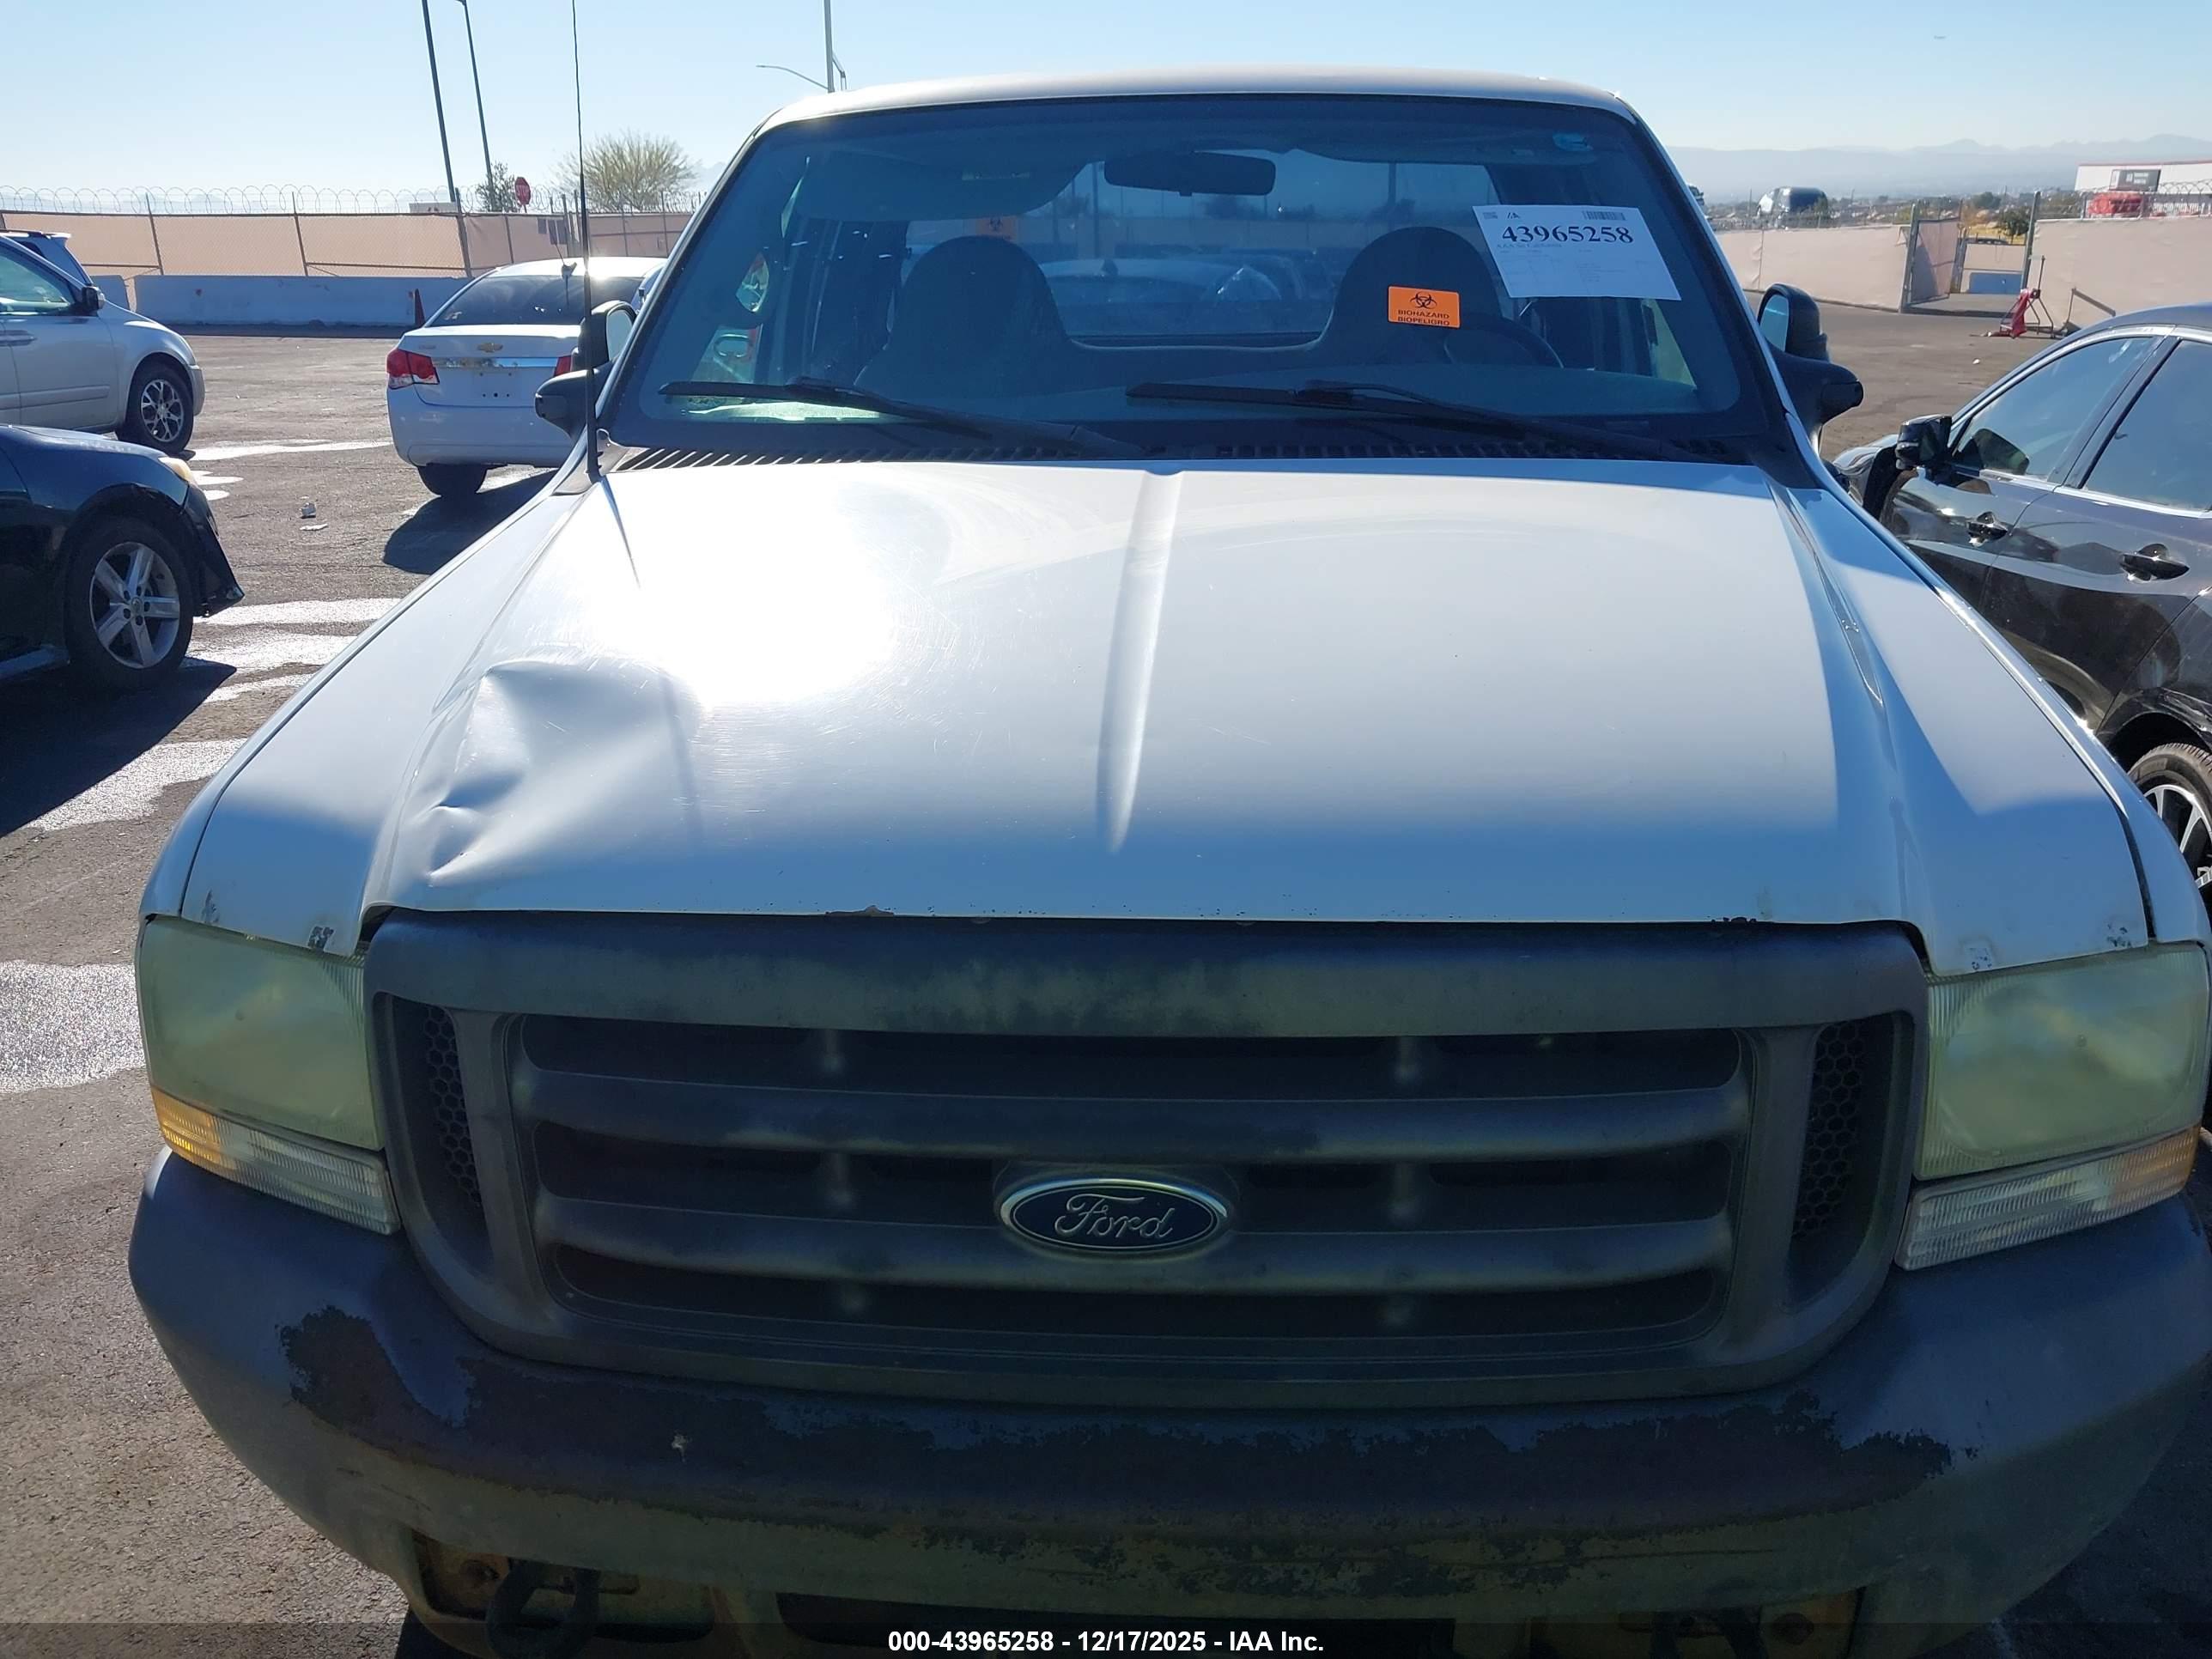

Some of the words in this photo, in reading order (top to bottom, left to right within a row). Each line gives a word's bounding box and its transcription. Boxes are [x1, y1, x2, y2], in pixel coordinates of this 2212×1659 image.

[1502, 225, 1634, 244] 43965258
[1397, 309, 1450, 319] BIOHAZARD
[1397, 316, 1450, 326] BIOPELIGRO
[1054, 1193, 1176, 1238] Ford
